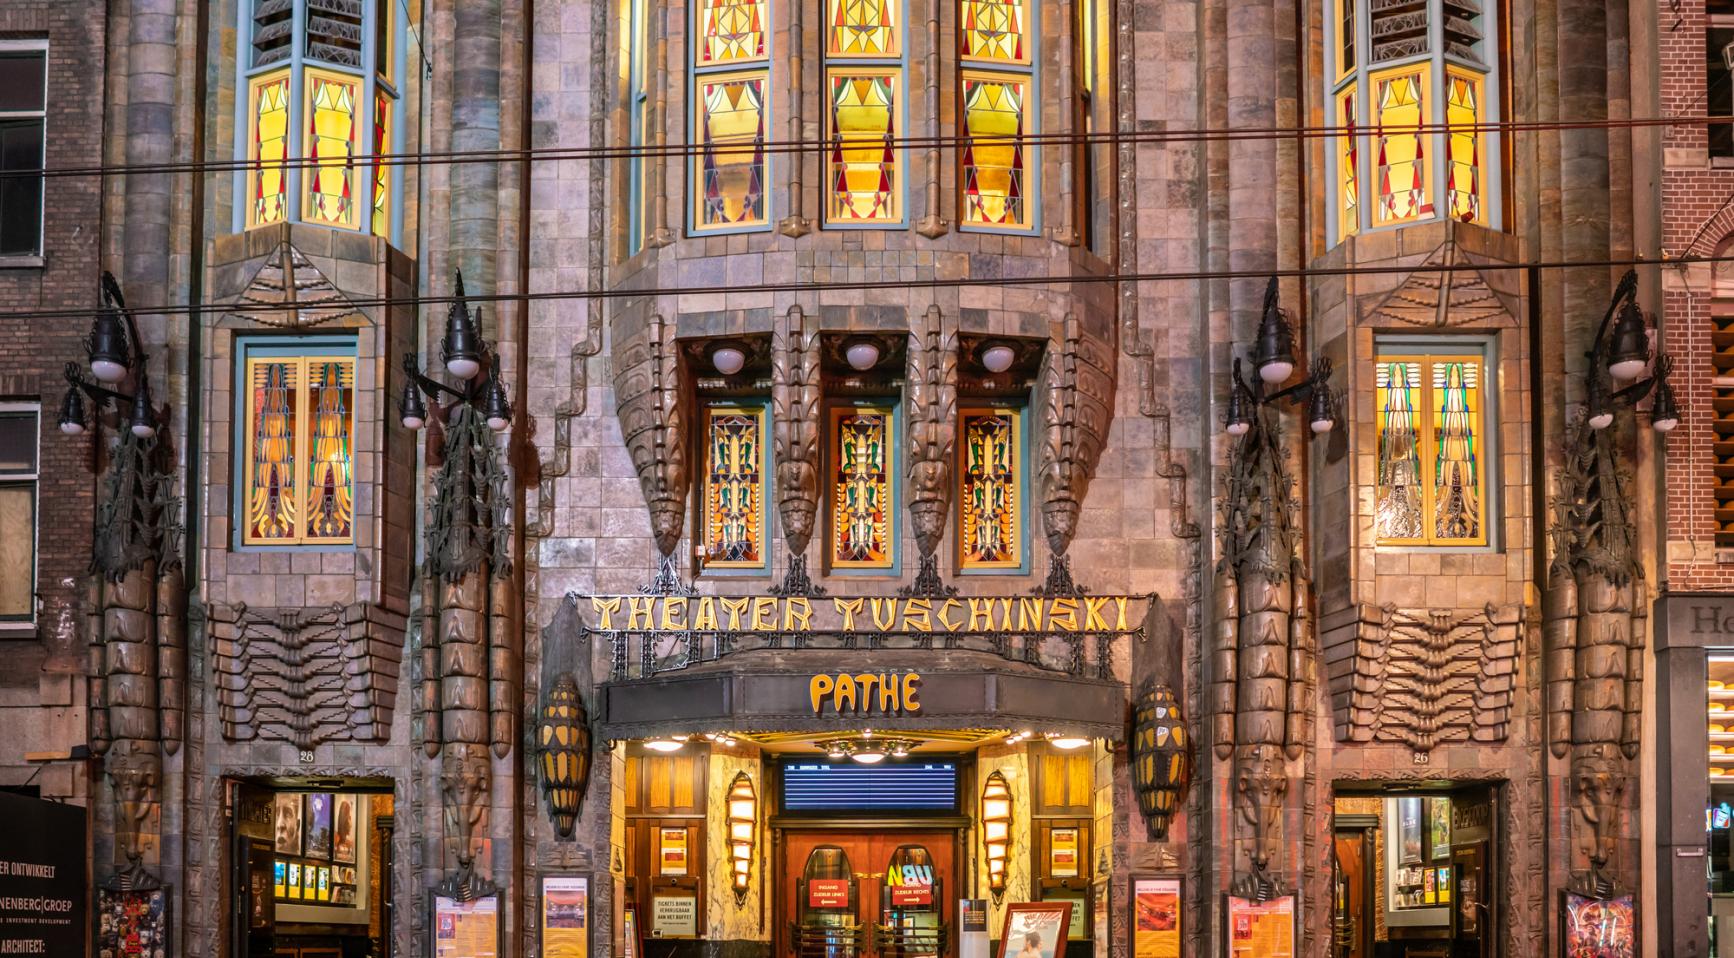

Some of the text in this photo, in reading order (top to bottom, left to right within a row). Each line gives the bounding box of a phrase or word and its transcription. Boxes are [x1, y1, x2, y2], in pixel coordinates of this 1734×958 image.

[592, 597, 1127, 632] THEATER TUSCHINSKI
[810, 673, 921, 713] PATHE
[300, 751, 314, 762] 28
[1414, 752, 1429, 763] 26
[11, 862, 56, 878] ONTWIKKELT
[1, 939, 46, 954] ARCHITECT:
